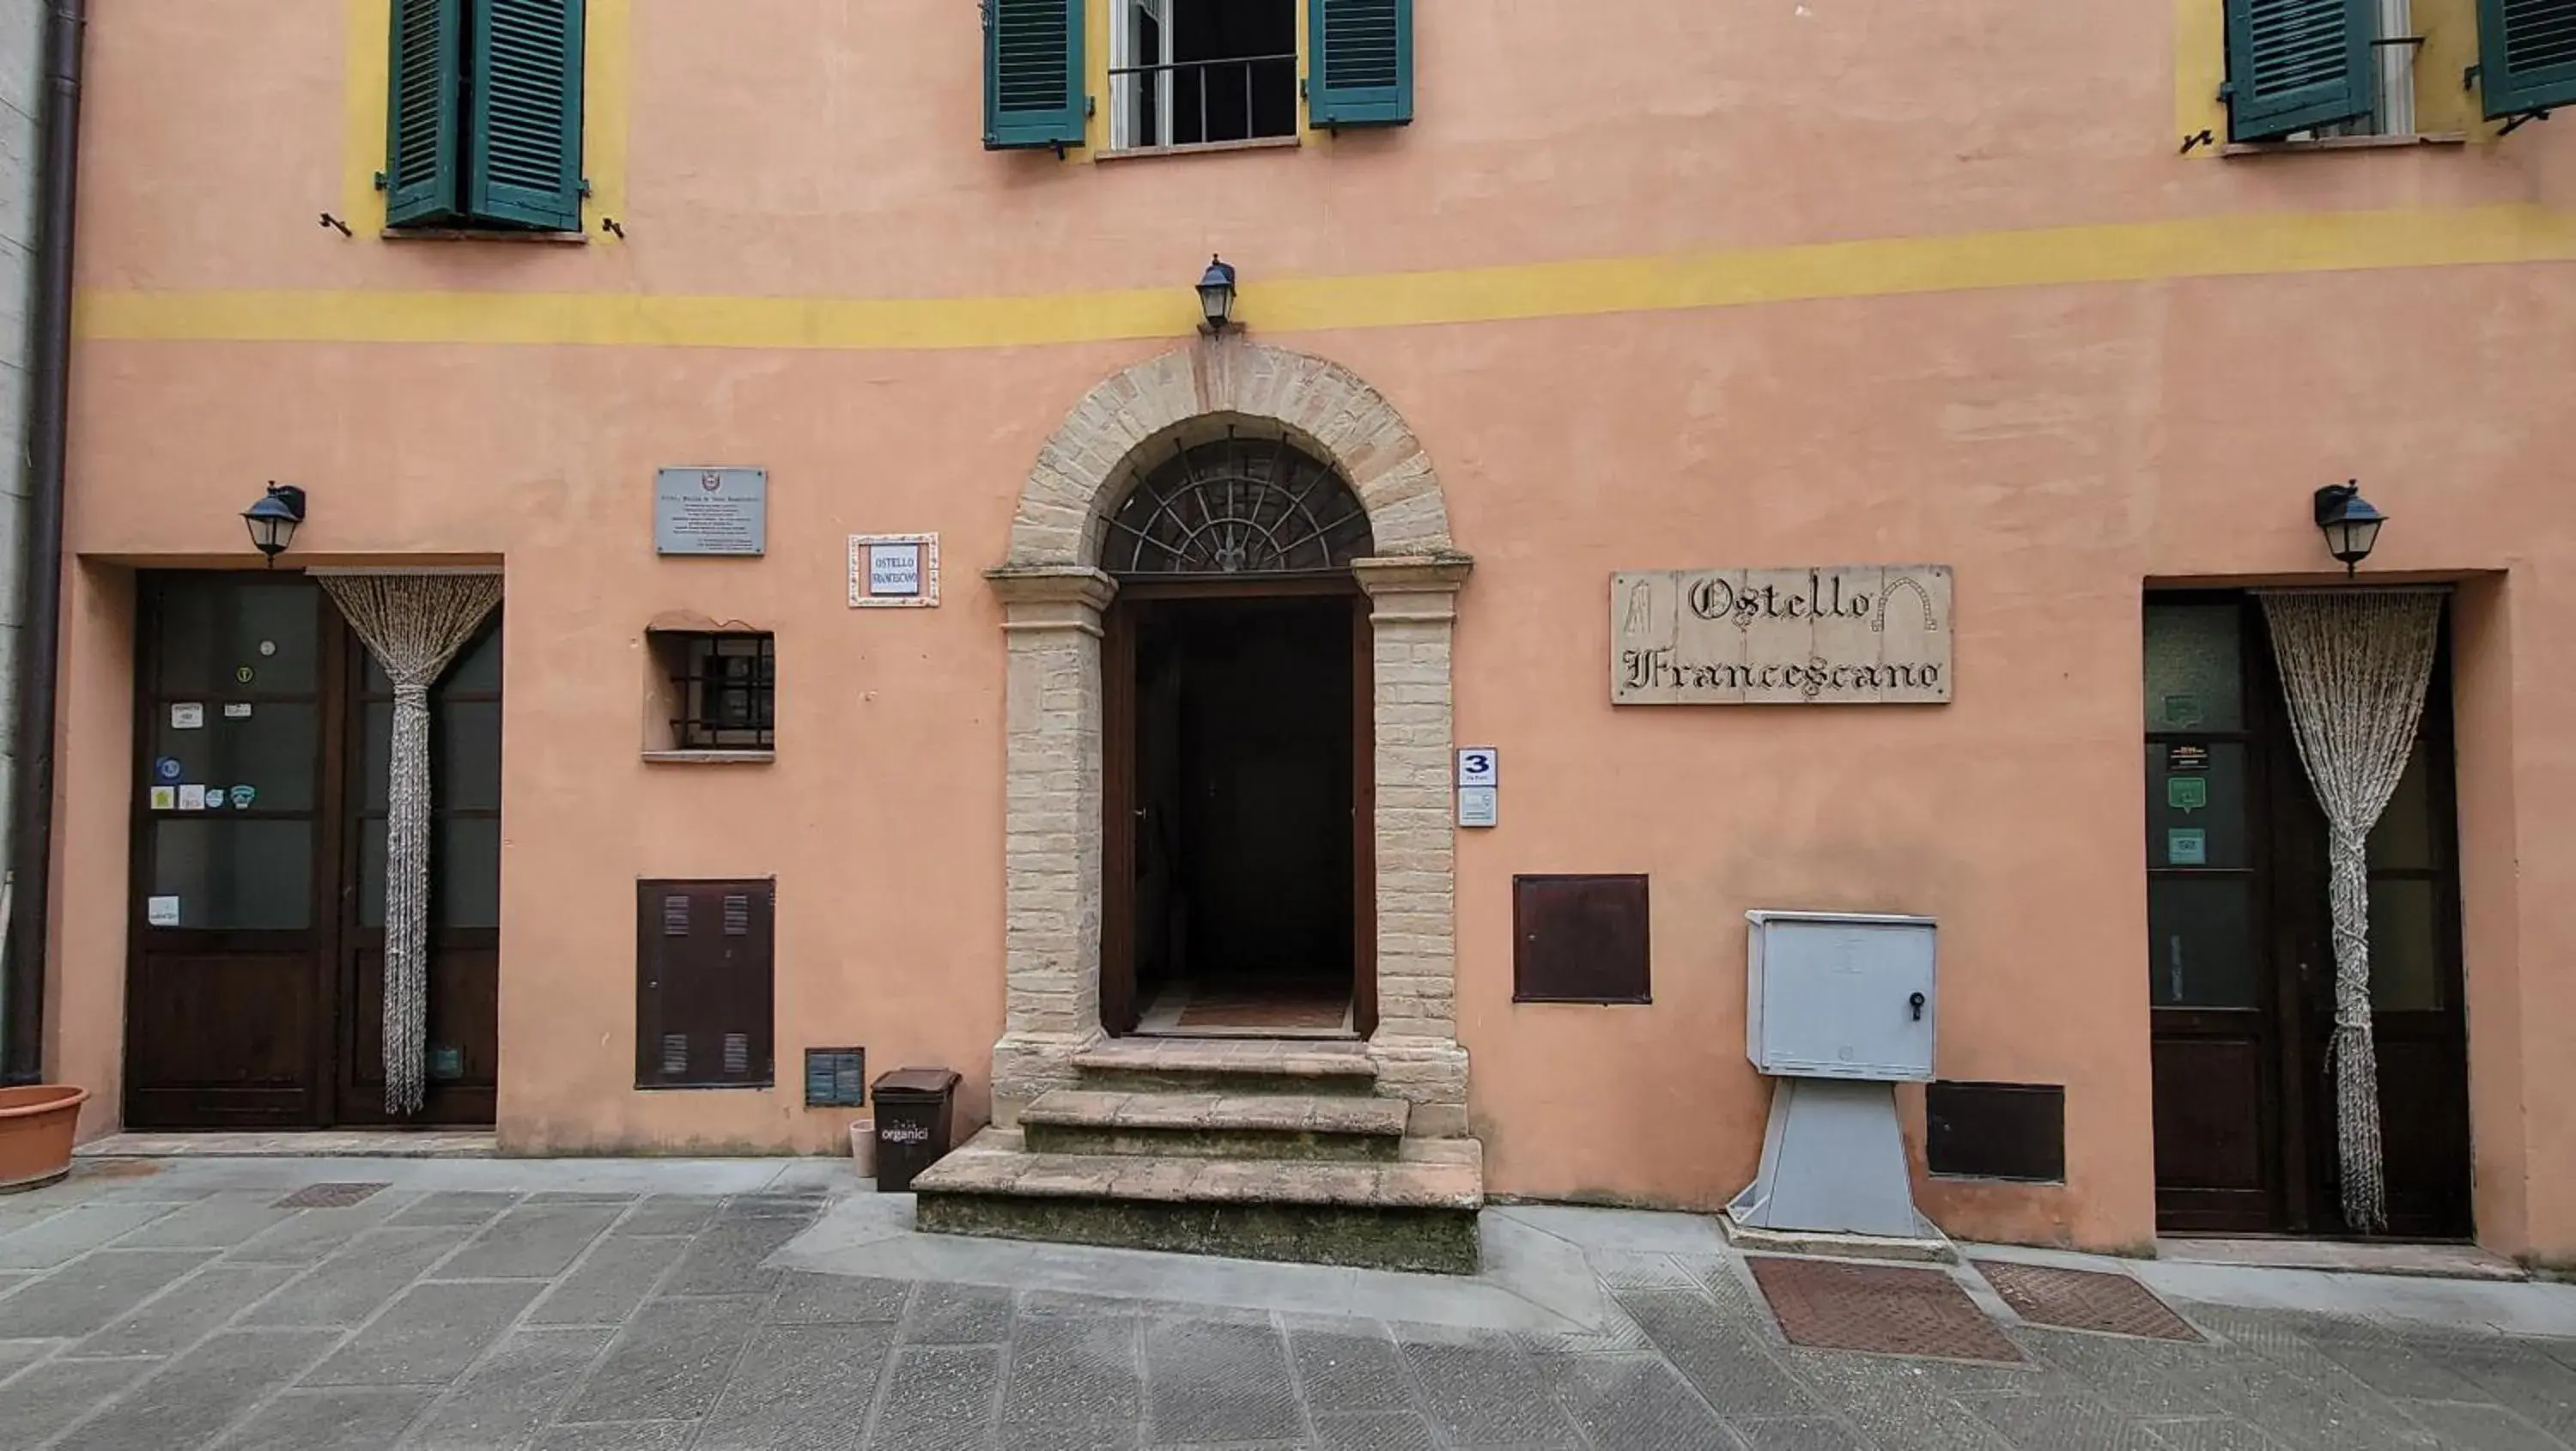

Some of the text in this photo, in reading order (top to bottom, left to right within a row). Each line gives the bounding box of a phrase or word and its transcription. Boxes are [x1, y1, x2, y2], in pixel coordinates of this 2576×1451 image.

[875, 557, 914, 568] OSTELLO
[1688, 574, 1873, 627] Ostello
[1622, 647, 1943, 697] Francescano
[1465, 755, 1490, 774] 3
[882, 1127, 928, 1142] organici
